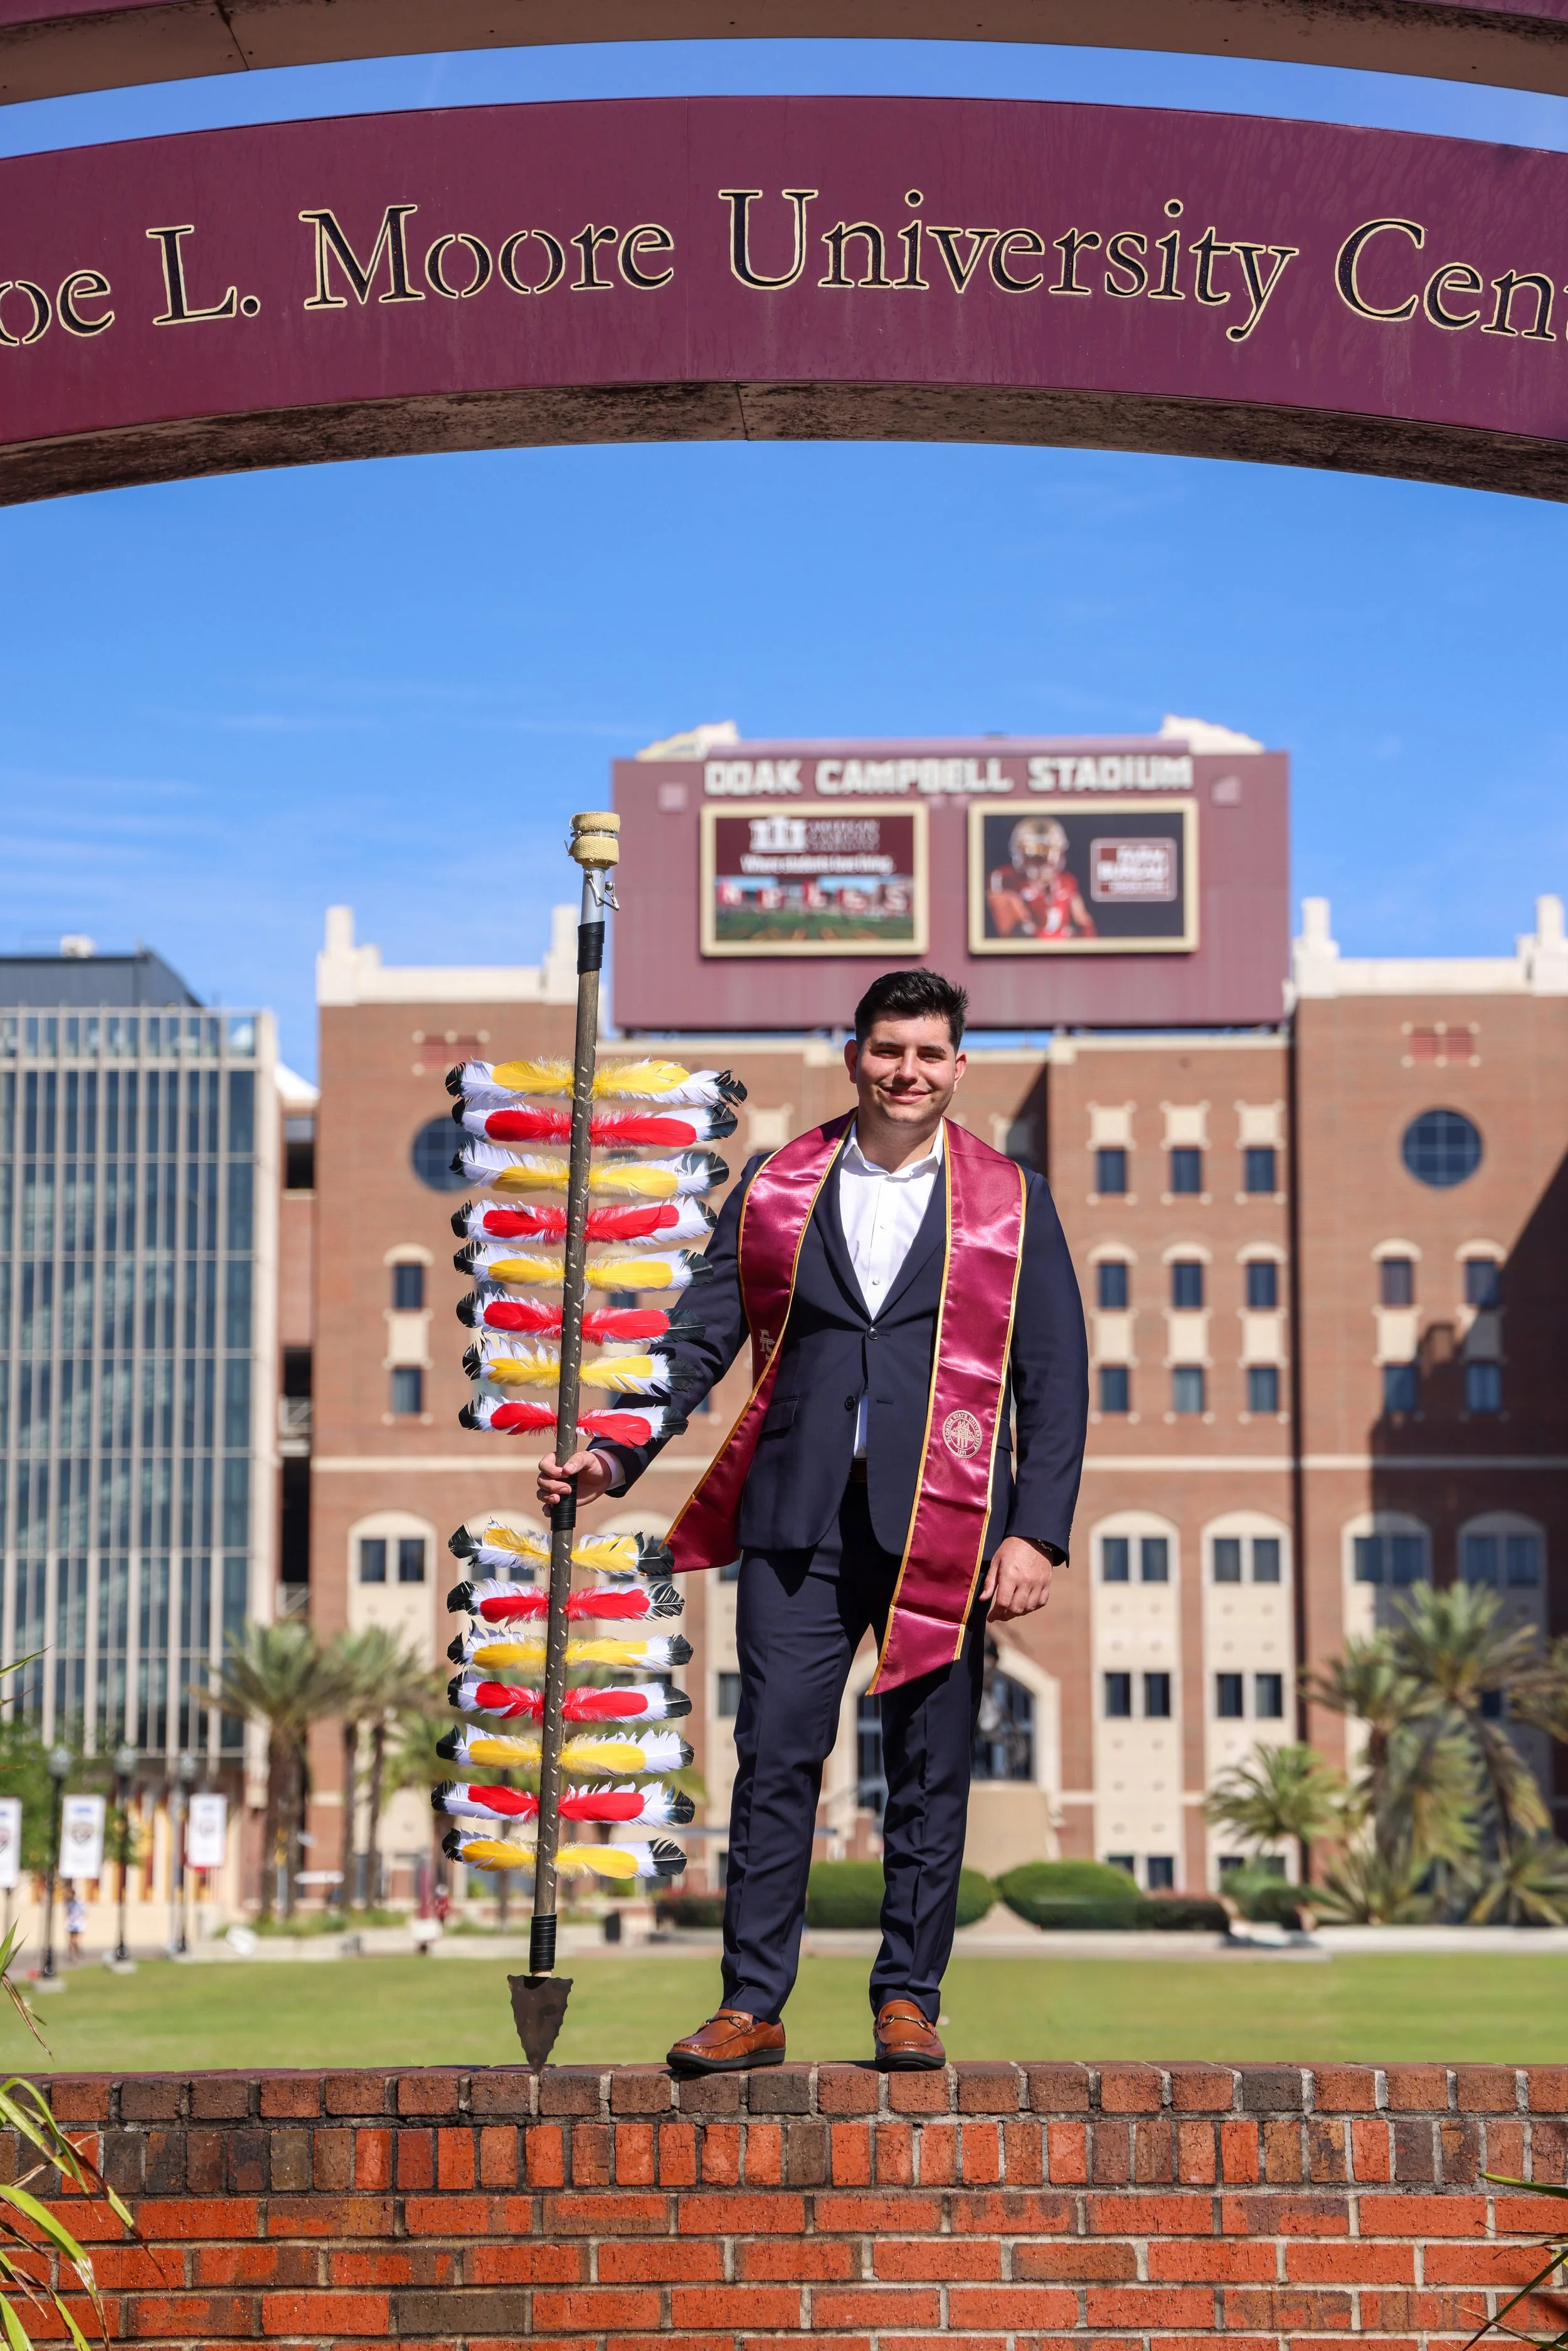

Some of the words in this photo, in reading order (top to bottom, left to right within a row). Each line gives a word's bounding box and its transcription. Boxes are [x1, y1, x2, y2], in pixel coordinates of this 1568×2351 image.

[145, 224, 262, 326] L.
[298, 203, 675, 310] Moore
[718, 188, 1299, 342] University
[1334, 217, 1568, 342] Cen
[704, 759, 803, 796] DOAK
[815, 758, 1015, 795] CAMPBELL
[1027, 755, 1194, 792] STADIUM
[945, 1418, 954, 1443] FLORIDA
[968, 1416, 980, 1450] UNIVERSITY
